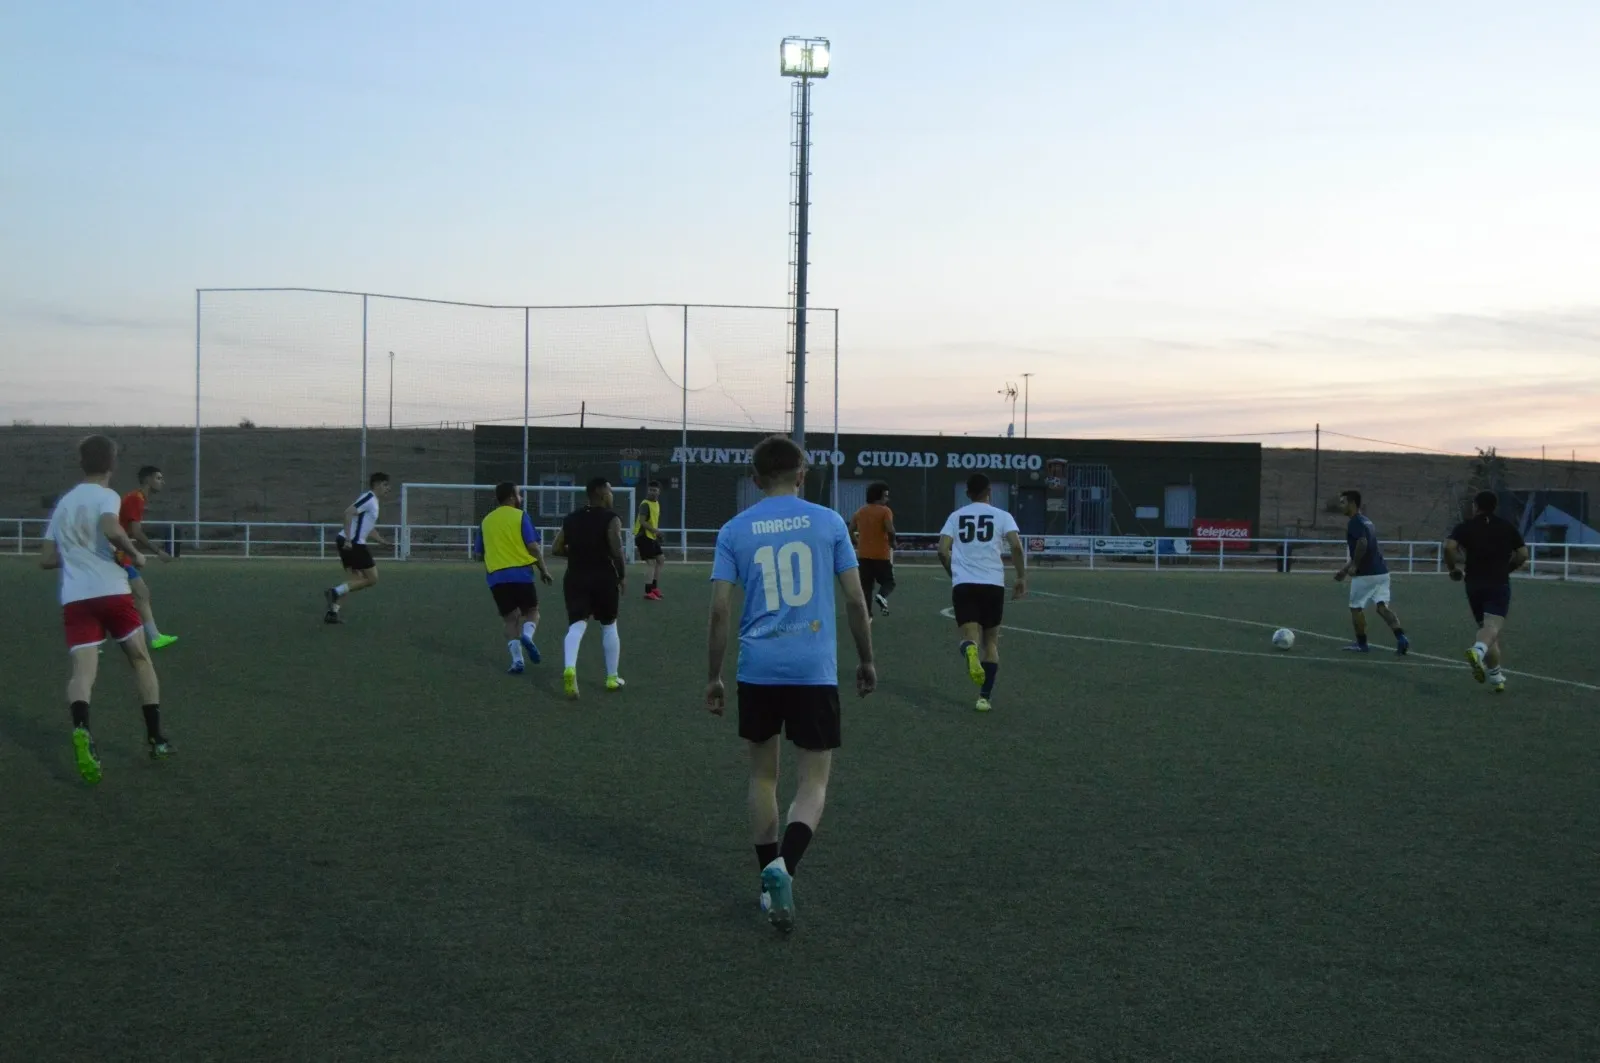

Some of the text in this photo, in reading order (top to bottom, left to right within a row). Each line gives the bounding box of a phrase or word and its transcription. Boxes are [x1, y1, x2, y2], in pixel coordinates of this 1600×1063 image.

[670, 447, 1042, 471] AYUNTANTO CIUDAD RODRIGO
[751, 515, 811, 535] MARCOS
[958, 514, 994, 543] 55
[1196, 525, 1249, 539] telepizza
[753, 541, 814, 612] 10
